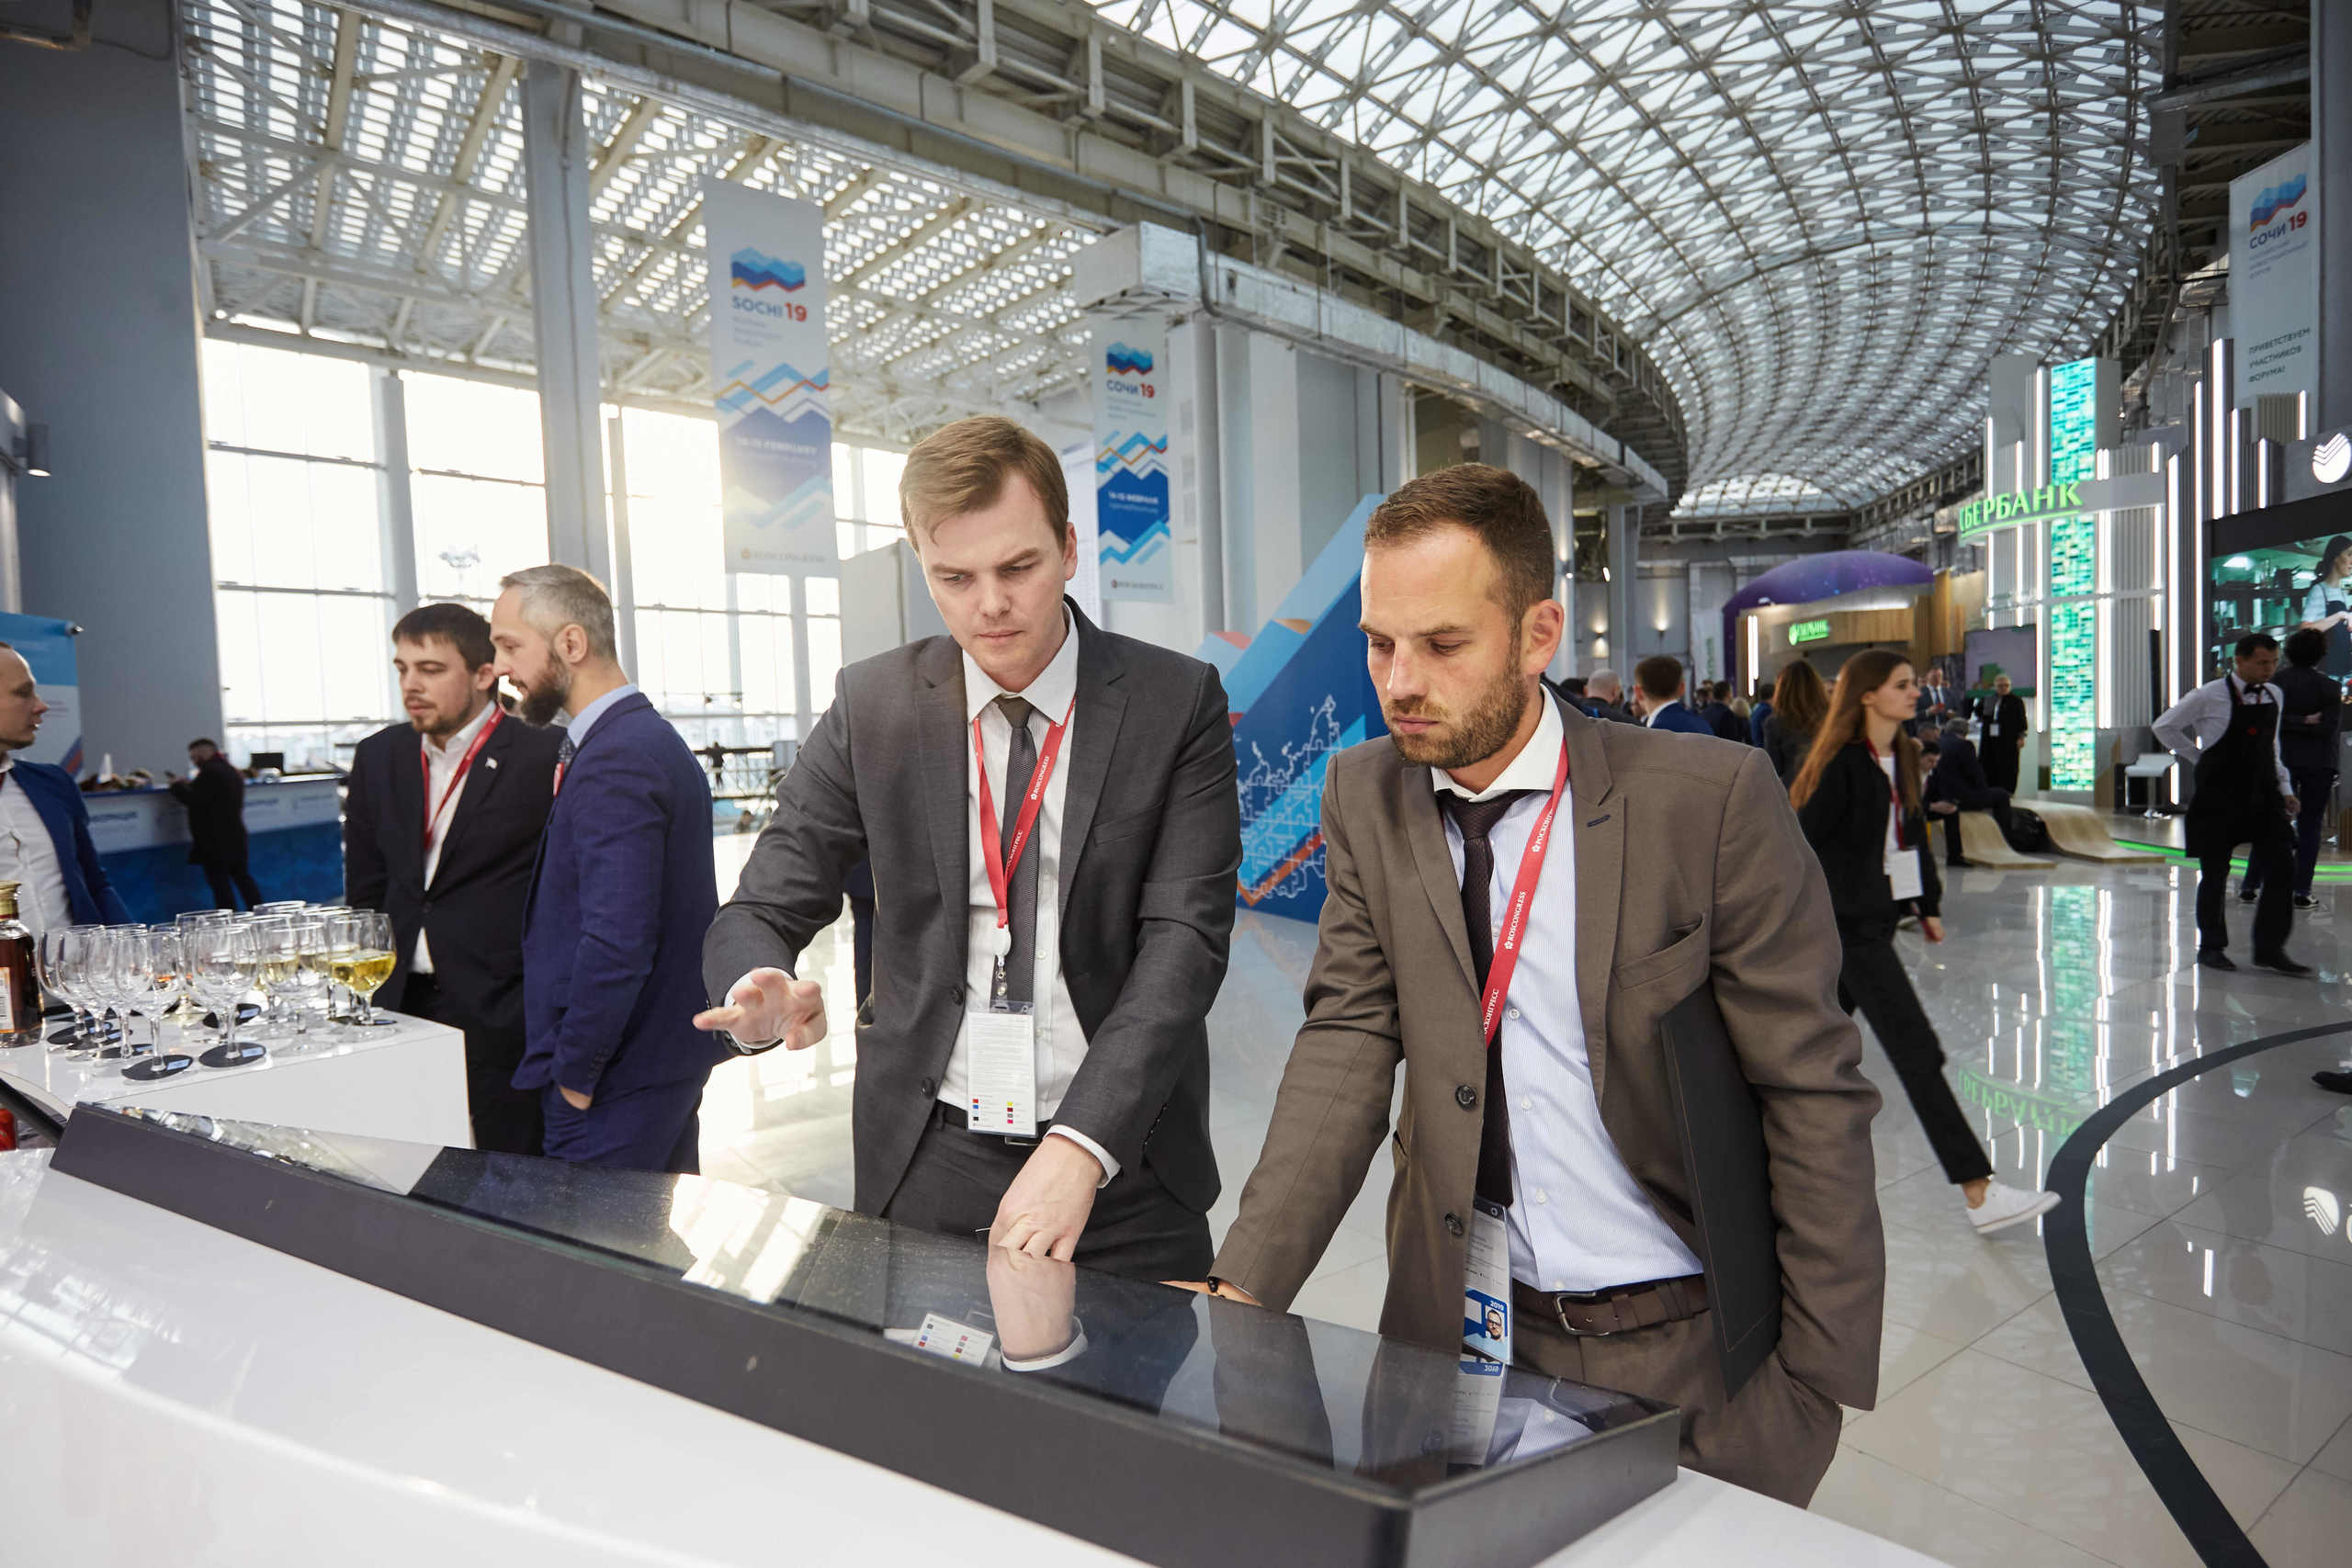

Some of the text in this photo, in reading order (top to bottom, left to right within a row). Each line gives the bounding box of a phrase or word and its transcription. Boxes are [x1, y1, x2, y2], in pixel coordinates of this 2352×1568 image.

[2249, 211, 2307, 249] СОЧИ 19
[731, 295, 783, 318] SOCHI
[785, 302, 808, 321] 19
[1106, 379, 1155, 399] СОЧИ 19
[1959, 480, 2083, 532] СБЕРБАНК
[1507, 891, 1526, 942] ROSCONGRESS
[1489, 1300, 1505, 1311] 2019
